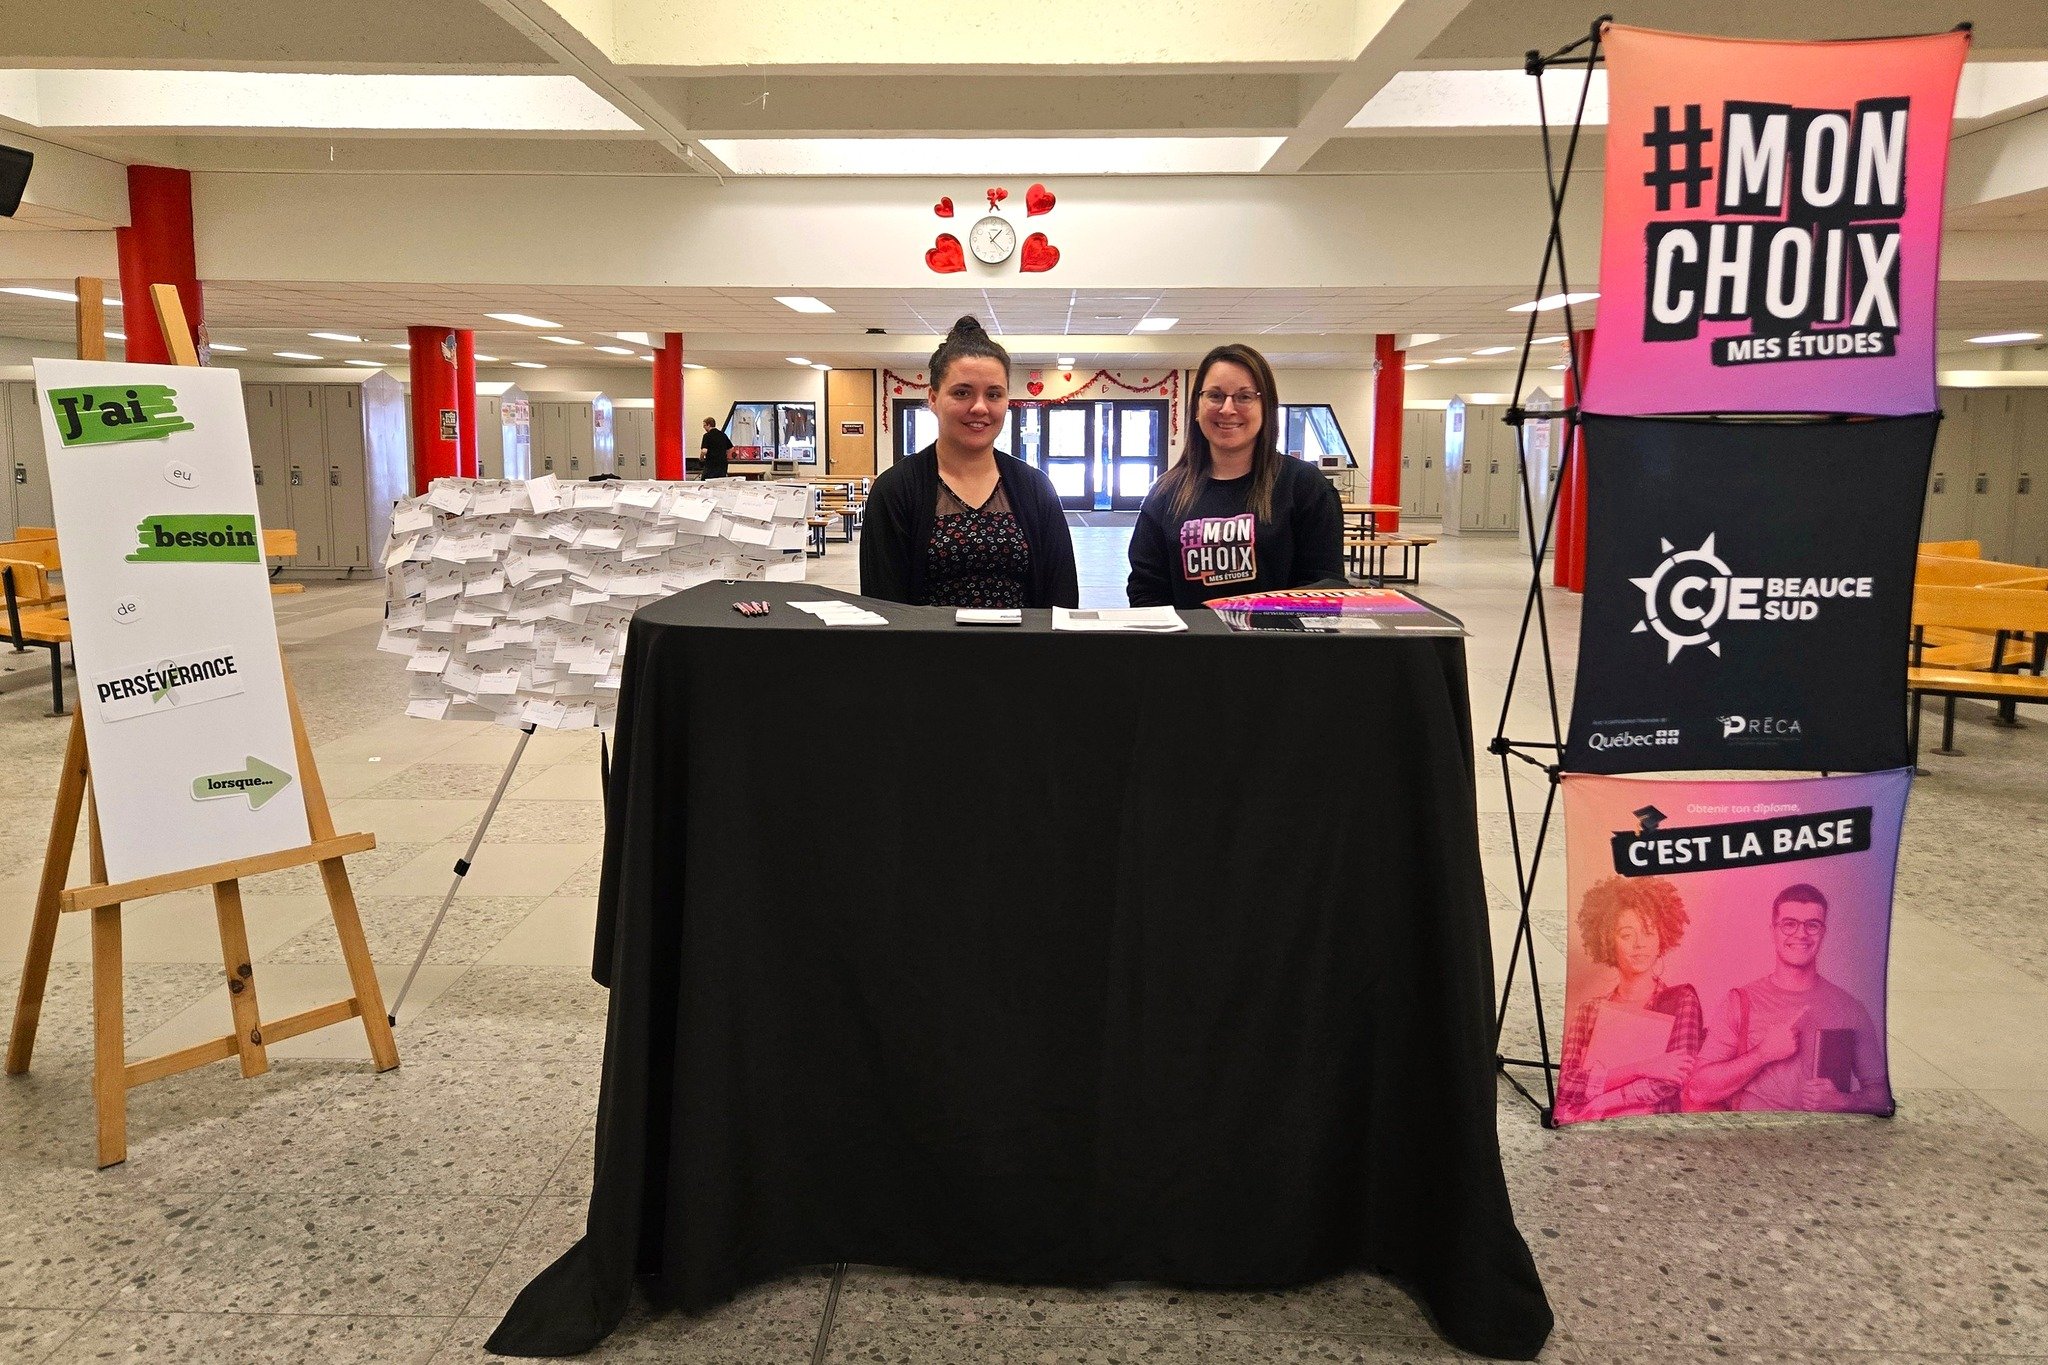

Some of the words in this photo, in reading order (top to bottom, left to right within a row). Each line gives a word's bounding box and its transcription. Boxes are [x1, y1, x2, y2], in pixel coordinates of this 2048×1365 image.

[1643, 104, 1908, 211] #MON
[1652, 224, 1901, 327] CHOIX
[1727, 337, 1781, 362] MES
[1788, 331, 1883, 358] ÉTUDES
[57, 389, 148, 441] J'ai
[173, 469, 192, 481] eu
[153, 524, 255, 548] besoin
[1180, 518, 1251, 546] #MON
[1187, 546, 1253, 574] CHOIX
[1208, 573, 1224, 582] MES
[1224, 571, 1250, 580] ÉTUDES
[117, 603, 137, 616] de
[1669, 576, 1765, 629] CJE
[1766, 577, 1873, 598] BEAUCE
[1764, 600, 1819, 620] SUD
[97, 655, 238, 703] PERSÉVÉRANCE
[1588, 731, 1654, 751] Québec
[207, 776, 273, 790] lorsque...
[1686, 803, 1729, 813] Obtenir
[1731, 804, 1751, 813] ton
[1628, 836, 1711, 867] C'EST
[1722, 832, 1764, 860] LA
[1773, 818, 1854, 854] BASE
